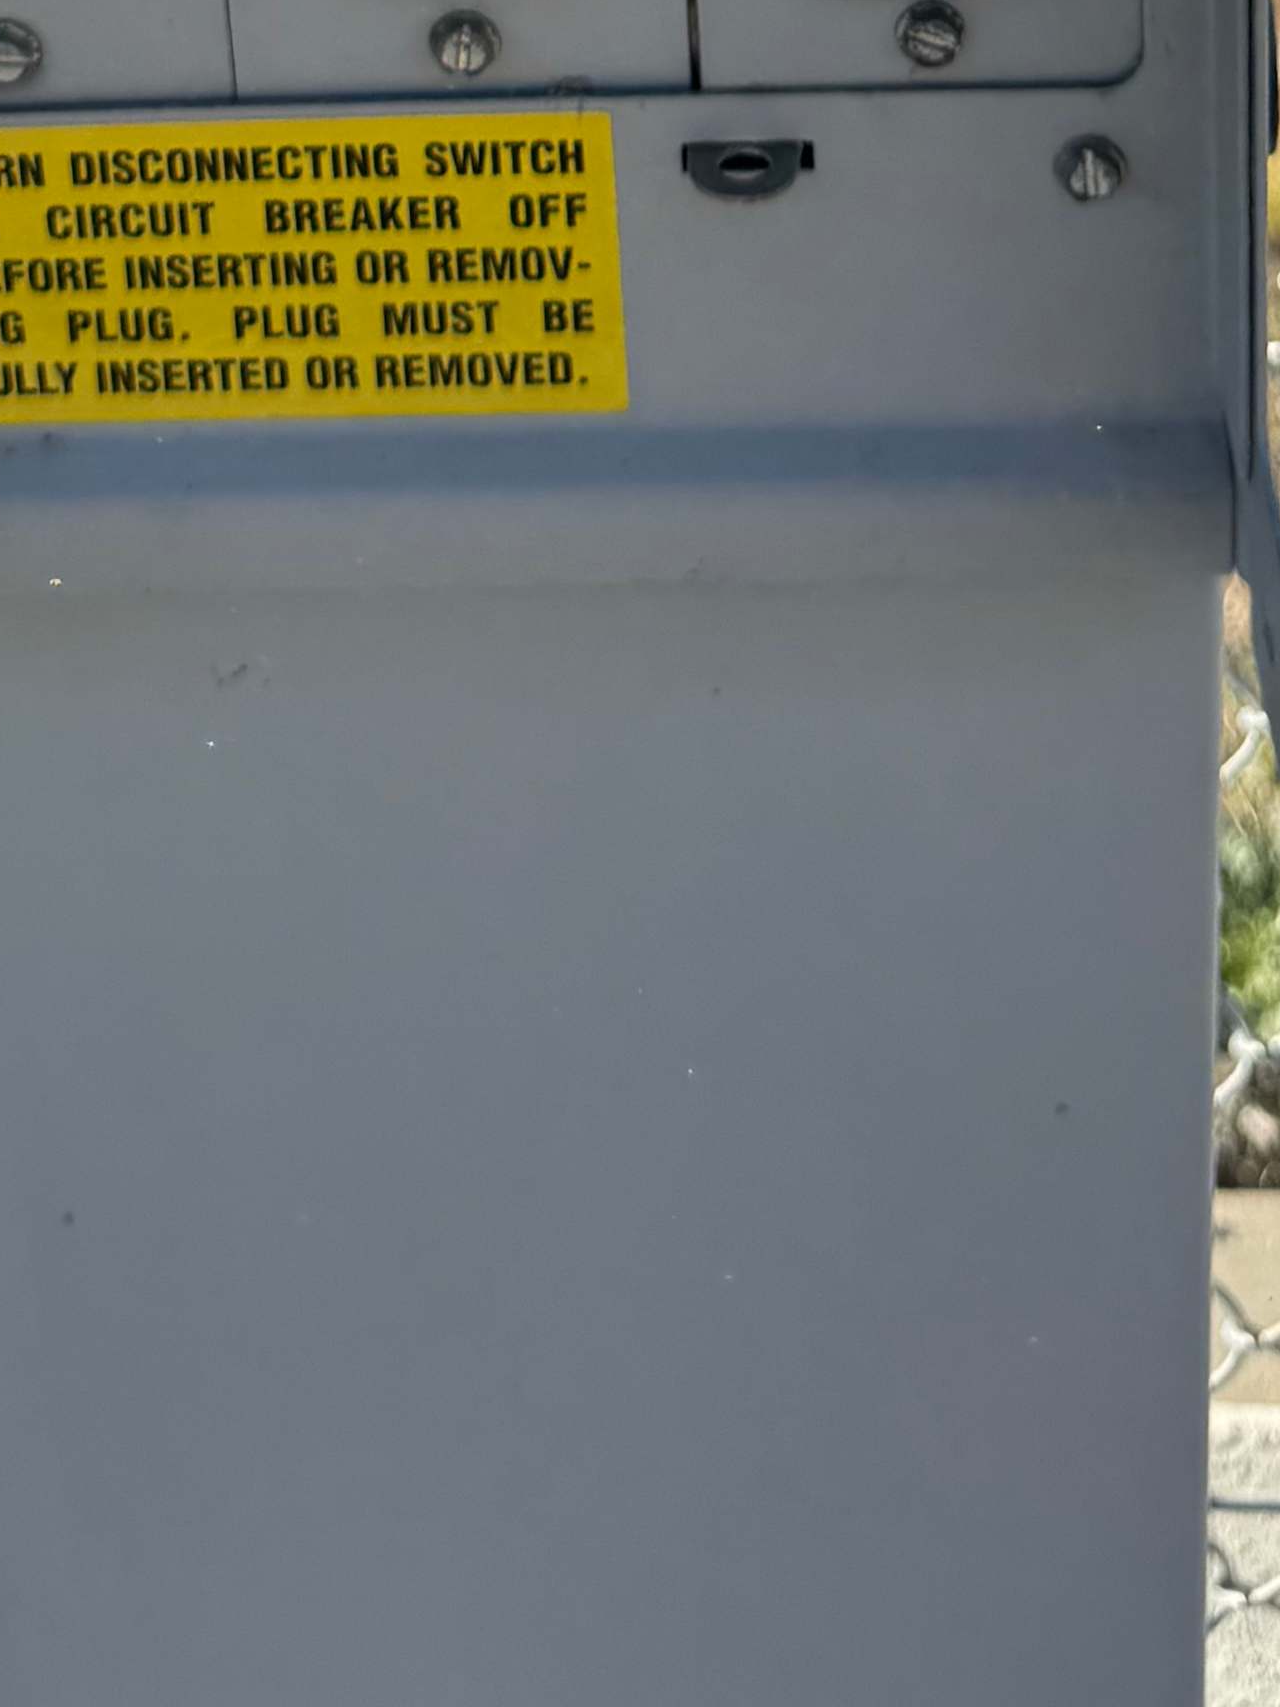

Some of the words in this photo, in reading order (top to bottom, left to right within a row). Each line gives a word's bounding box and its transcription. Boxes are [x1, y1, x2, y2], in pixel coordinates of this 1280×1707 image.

[71, 145, 399, 186] DISCONNECTING
[424, 139, 585, 178] SWITCH
[47, 201, 216, 238] CIRCUIT
[264, 196, 460, 235] BREAKER
[508, 193, 586, 228] OFF
[125, 251, 336, 291] INSERTING
[356, 249, 408, 286] OR
[427, 247, 591, 283] REMOV-
[69, 307, 191, 343] PLUG.
[233, 303, 339, 338] PLUG
[383, 302, 499, 336] MUST
[544, 299, 594, 333] BE
[97, 358, 289, 393] INSERTED
[306, 355, 360, 391] OR
[375, 352, 589, 389] REMOVED.
